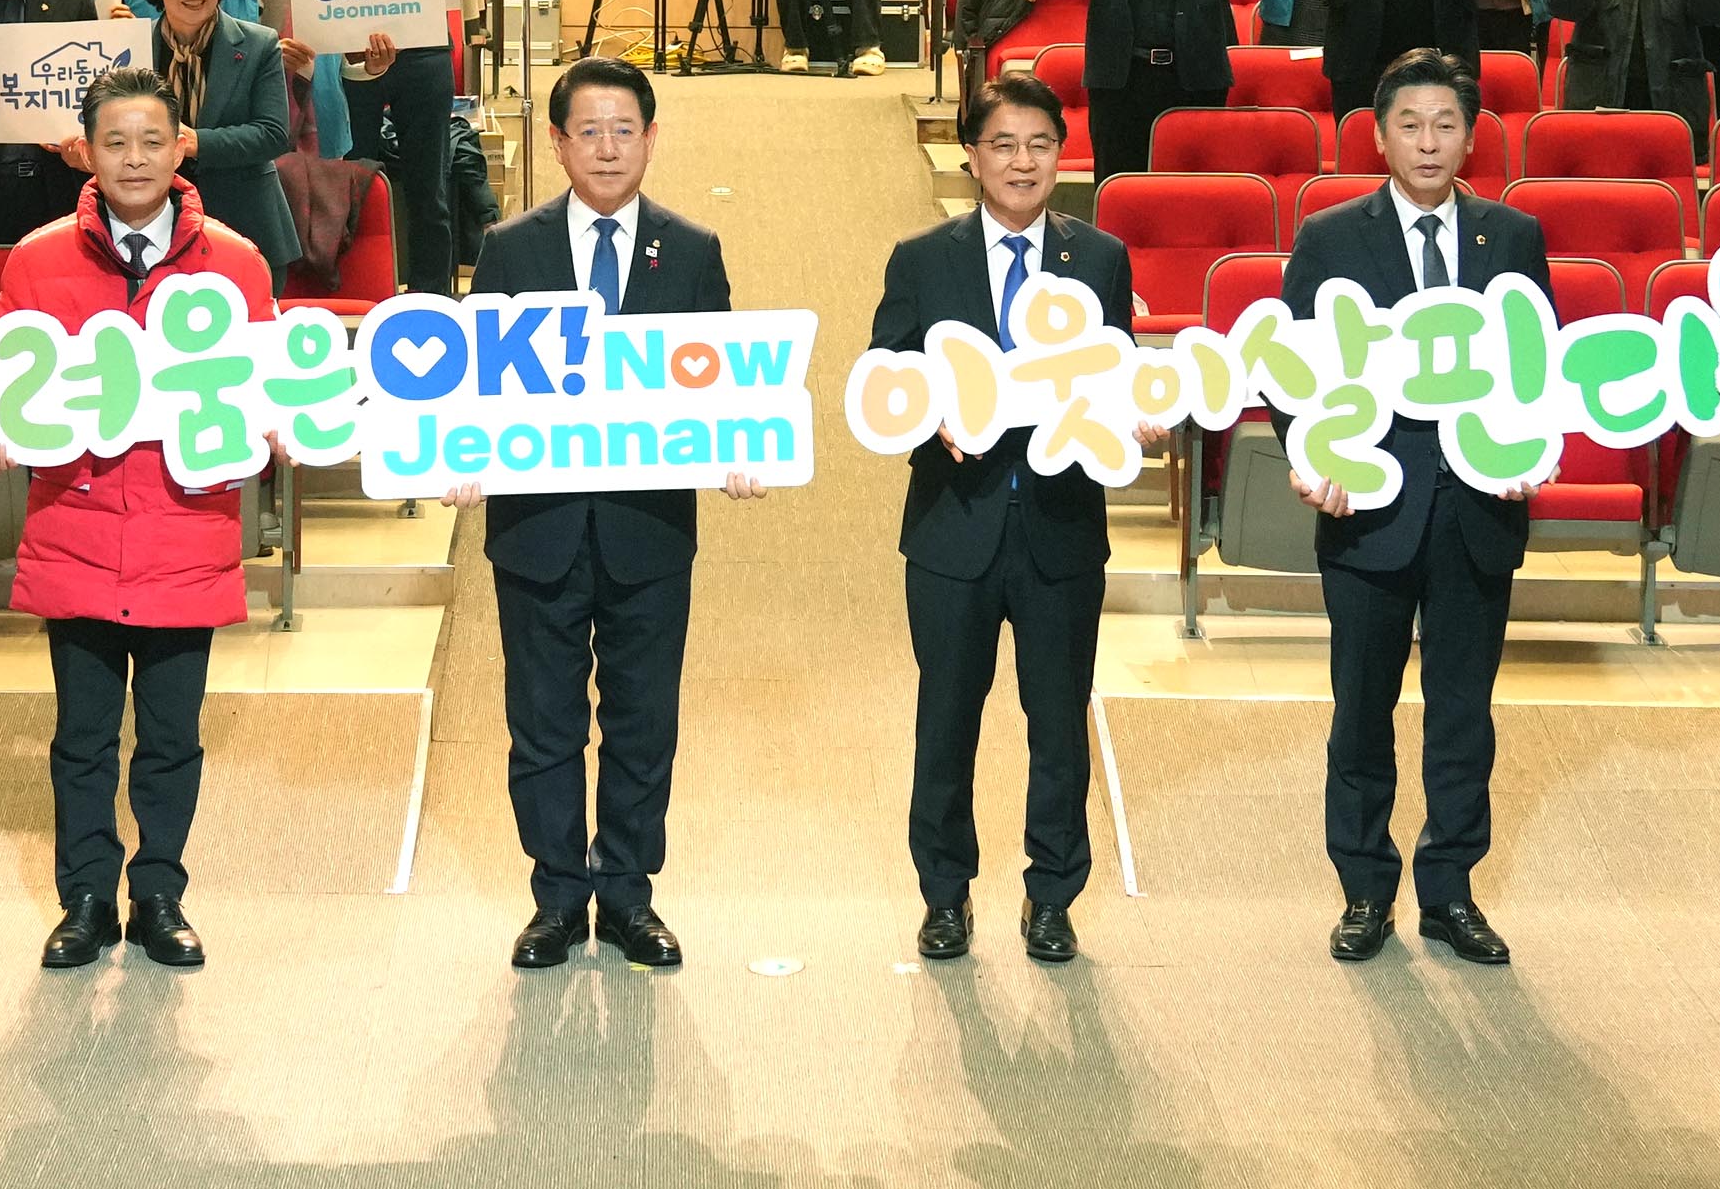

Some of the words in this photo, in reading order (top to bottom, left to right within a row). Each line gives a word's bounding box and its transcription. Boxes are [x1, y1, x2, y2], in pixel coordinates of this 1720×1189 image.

[32, 58, 111, 85] 우리동네
[369, 304, 589, 401] OK!
[605, 329, 791, 391] Now
[861, 288, 1230, 472] 이웃이
[382, 414, 795, 478] Jeonnam
